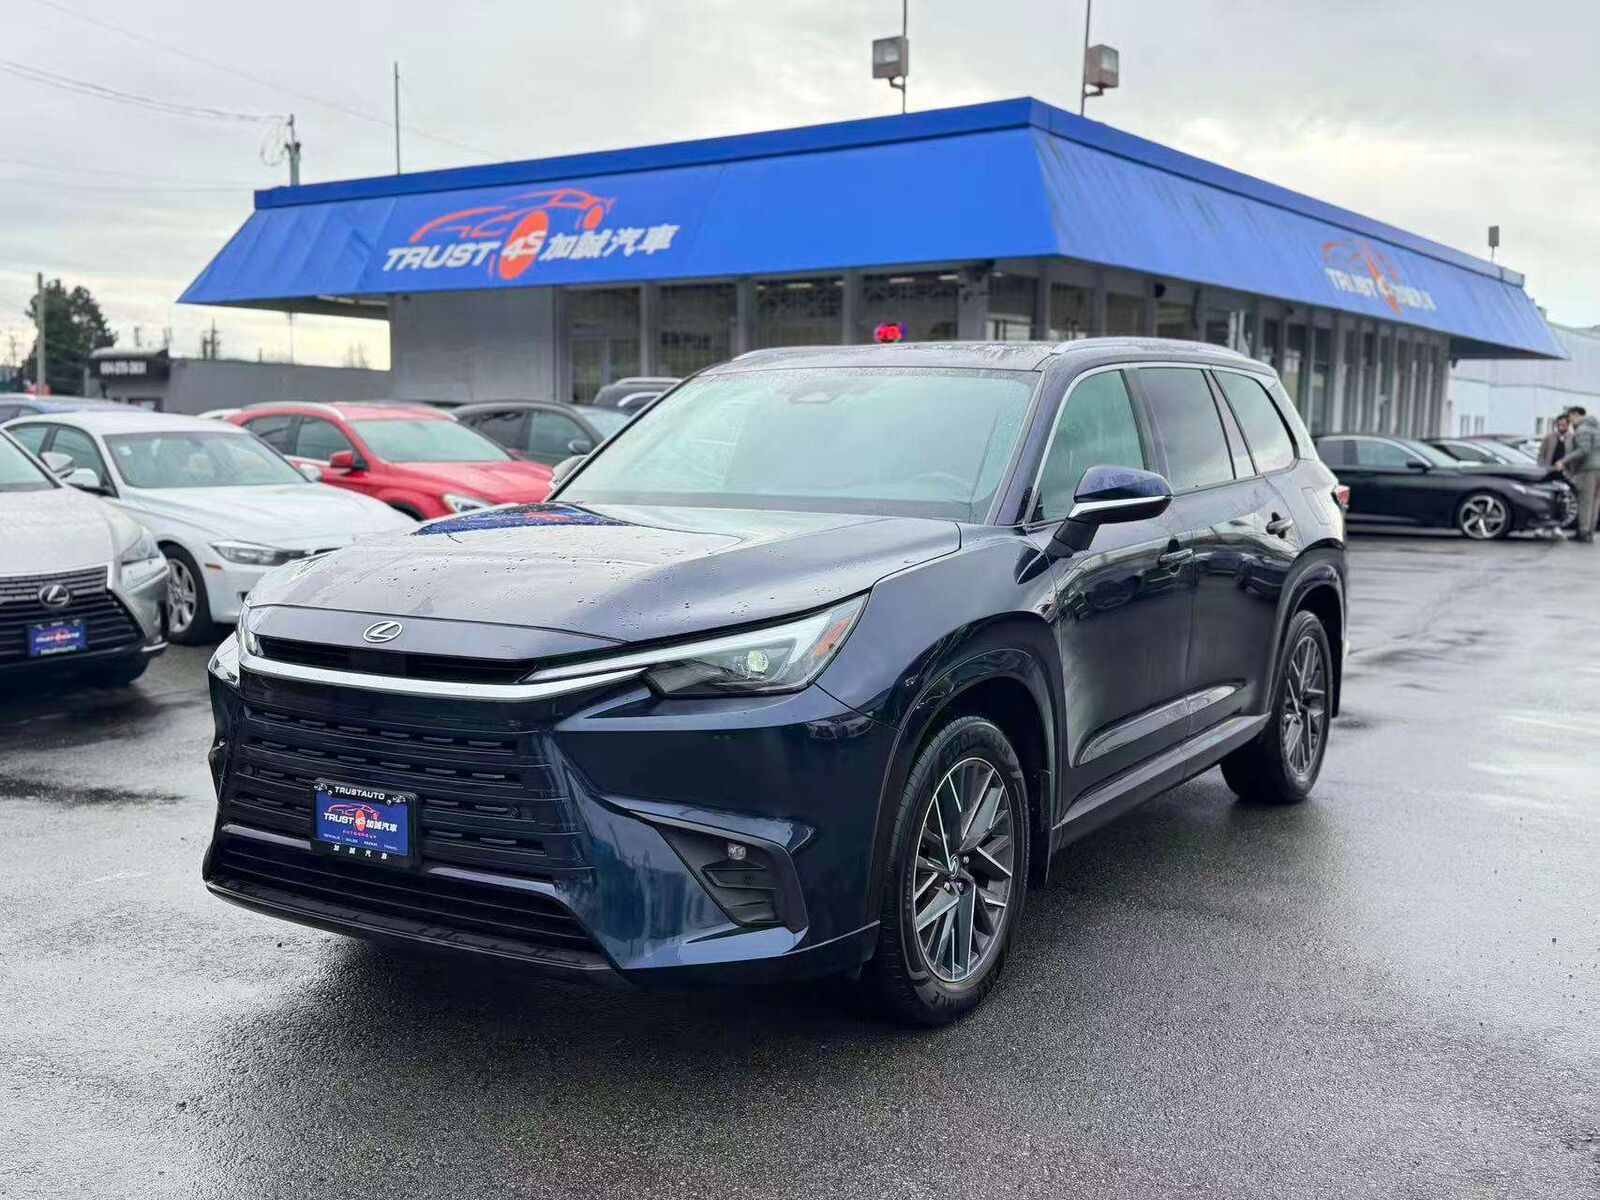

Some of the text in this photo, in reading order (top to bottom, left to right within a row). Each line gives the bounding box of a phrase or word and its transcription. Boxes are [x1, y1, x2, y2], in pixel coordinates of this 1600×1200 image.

[383, 241, 500, 272] TRUST
[502, 230, 547, 260] 4S
[334, 786, 386, 800] TRUSTAUTO
[323, 812, 354, 825] TRUST
